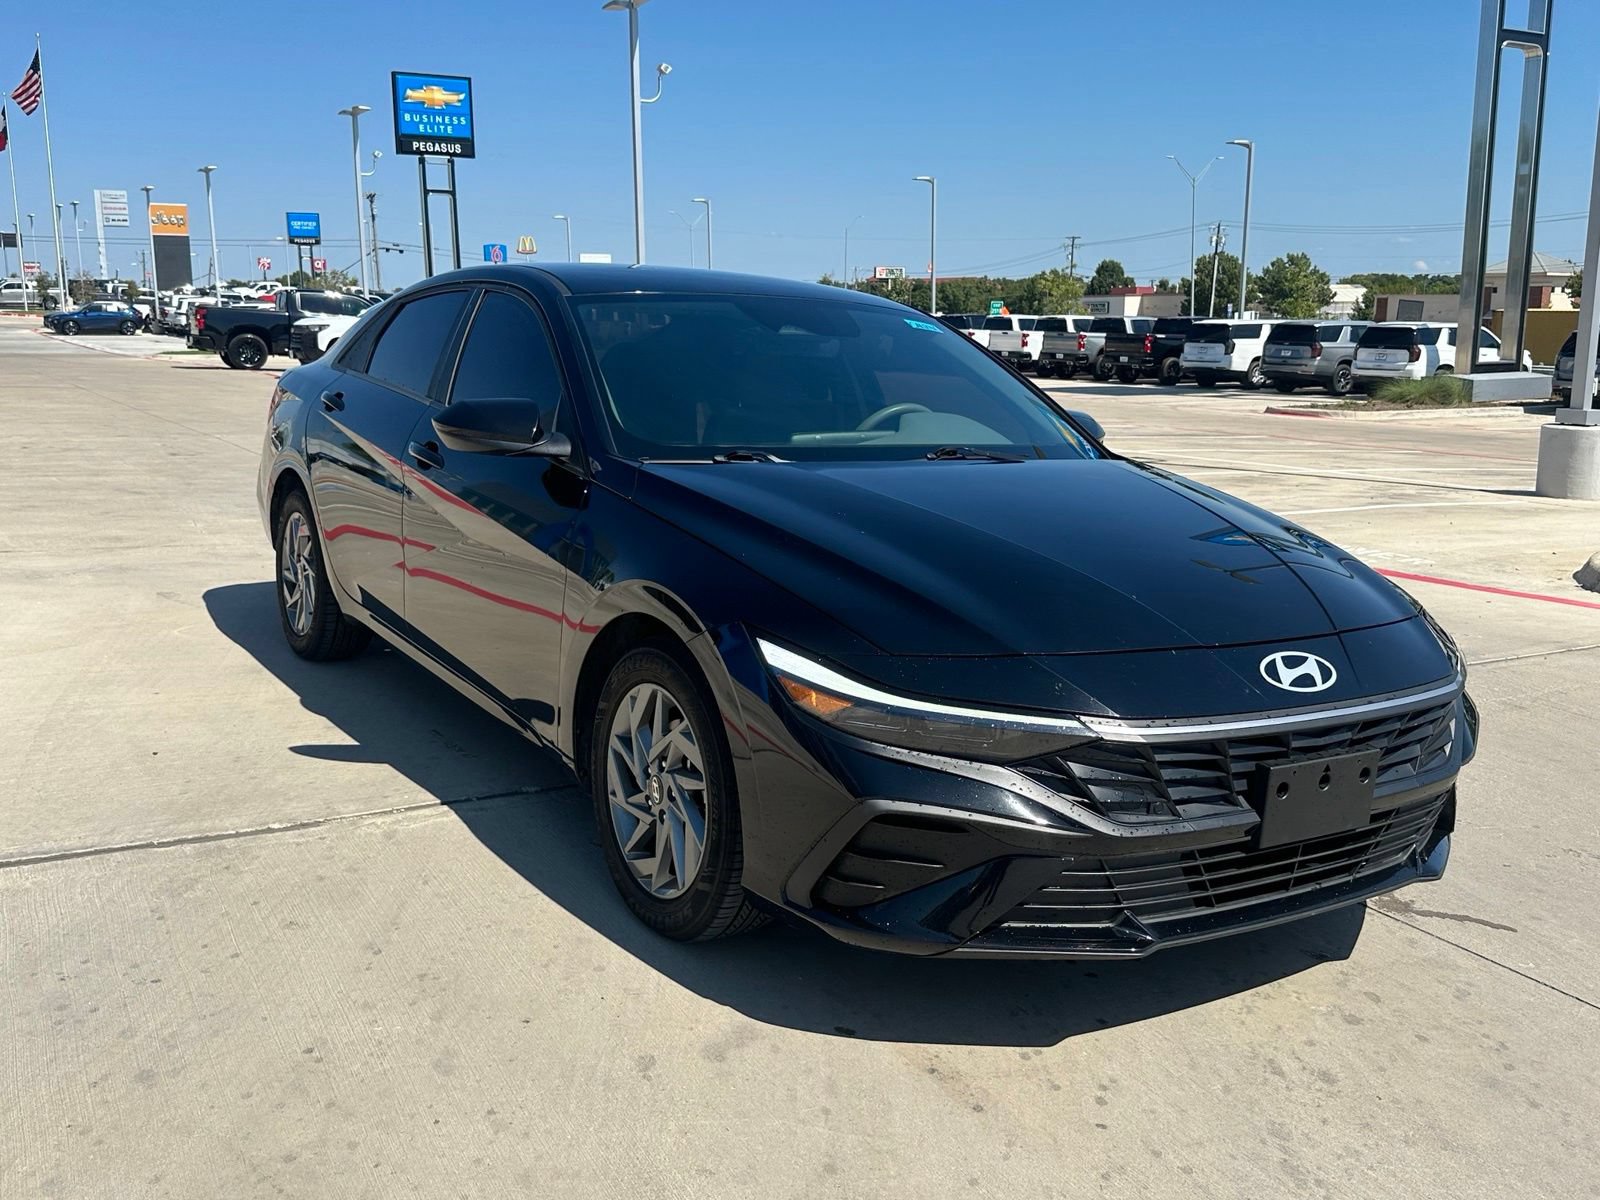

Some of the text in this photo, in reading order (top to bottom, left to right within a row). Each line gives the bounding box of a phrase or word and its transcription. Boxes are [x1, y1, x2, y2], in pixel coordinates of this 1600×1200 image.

[404, 113, 466, 125] BUSINESS
[419, 124, 453, 134] ELITE
[412, 141, 462, 153] PEGASUS
